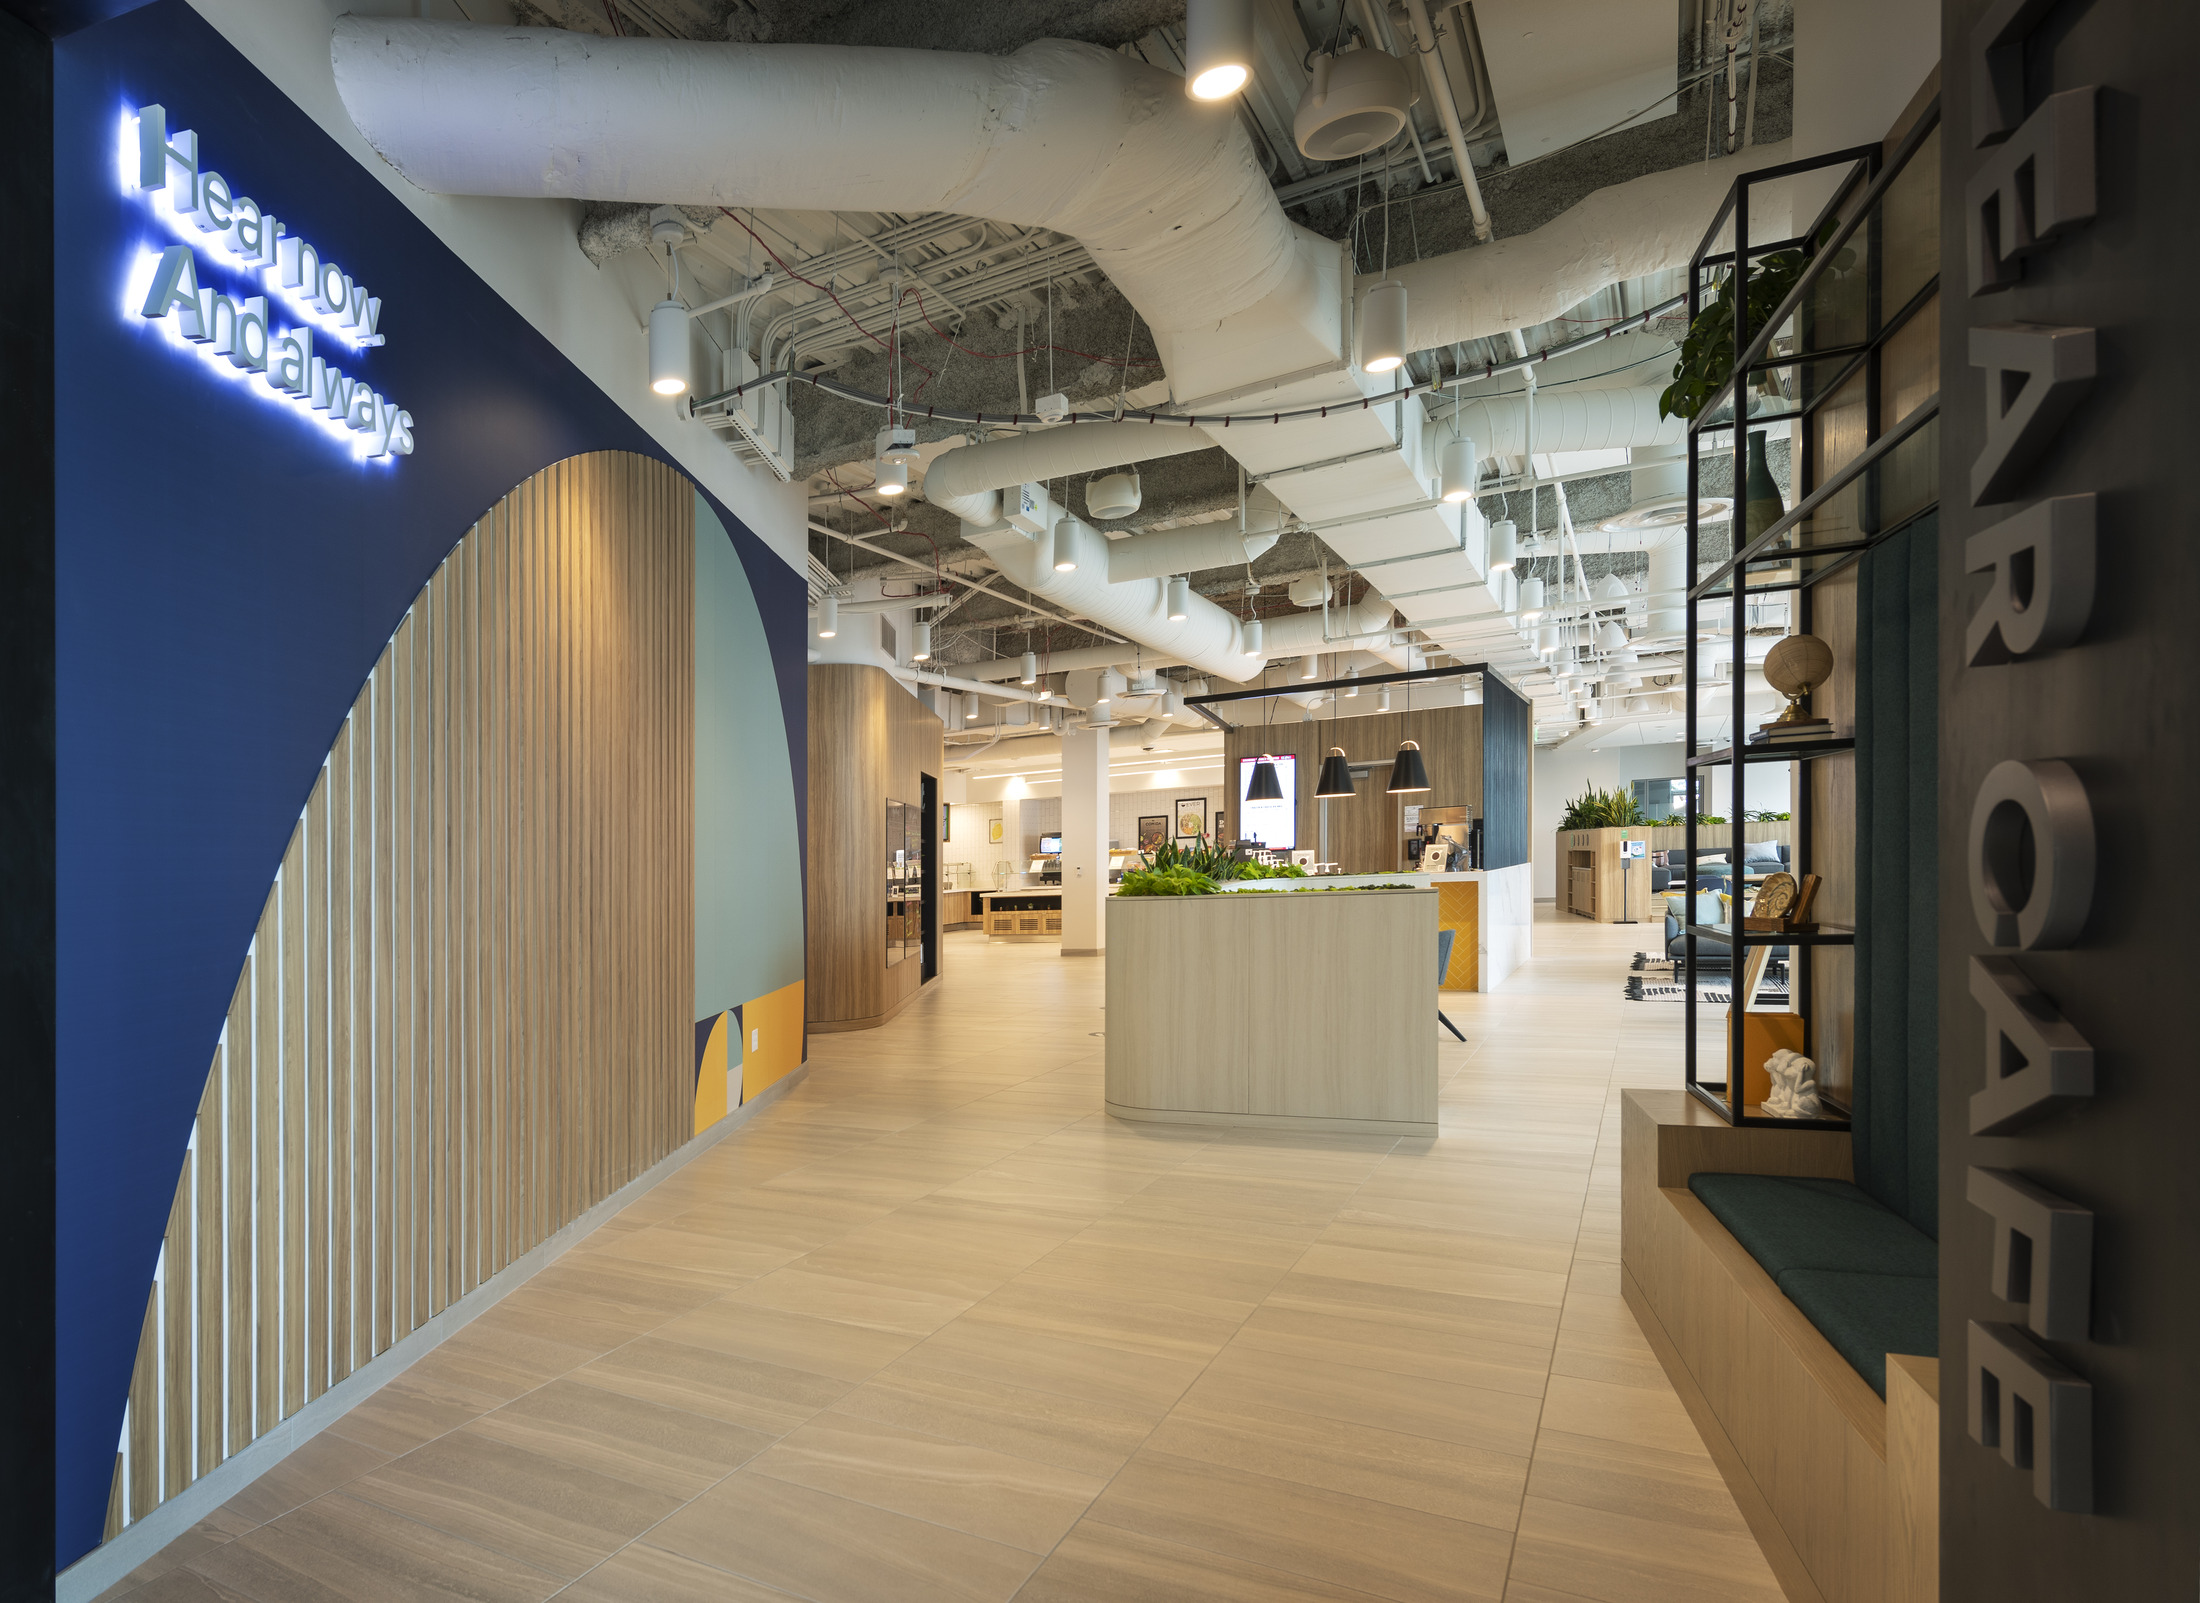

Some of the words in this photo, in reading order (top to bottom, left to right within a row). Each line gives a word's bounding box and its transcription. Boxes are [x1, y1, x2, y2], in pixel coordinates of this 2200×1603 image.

[139, 103, 285, 269] Hear
[141, 245, 268, 374] And
[266, 326, 414, 458] always
[1968, 758, 2095, 1515] CAFE
